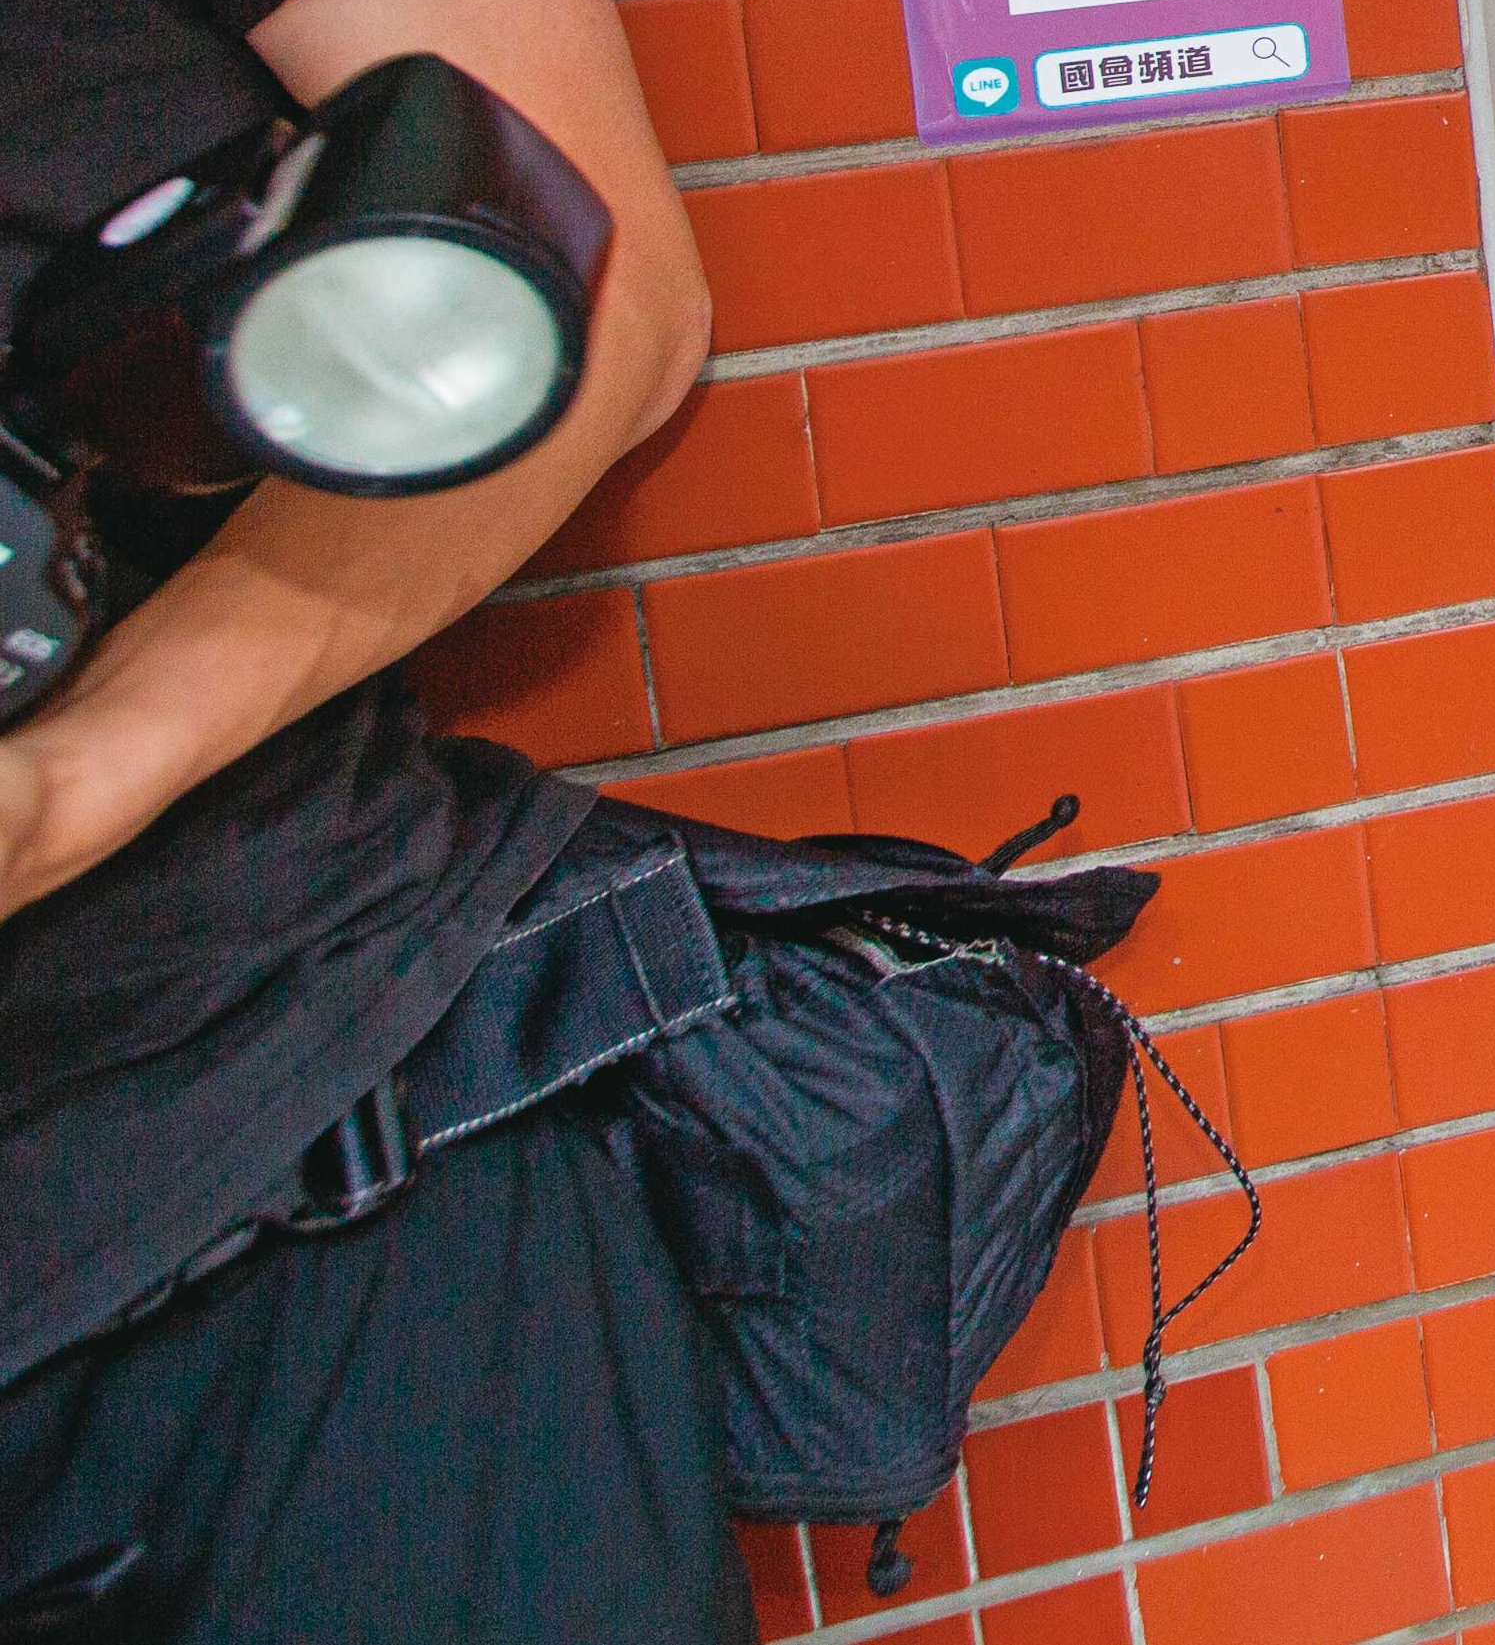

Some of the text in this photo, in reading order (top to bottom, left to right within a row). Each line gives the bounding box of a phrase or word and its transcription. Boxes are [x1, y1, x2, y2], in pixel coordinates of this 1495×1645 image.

[969, 75, 1003, 92] LINE
[1059, 45, 1214, 94] 國會頻道
